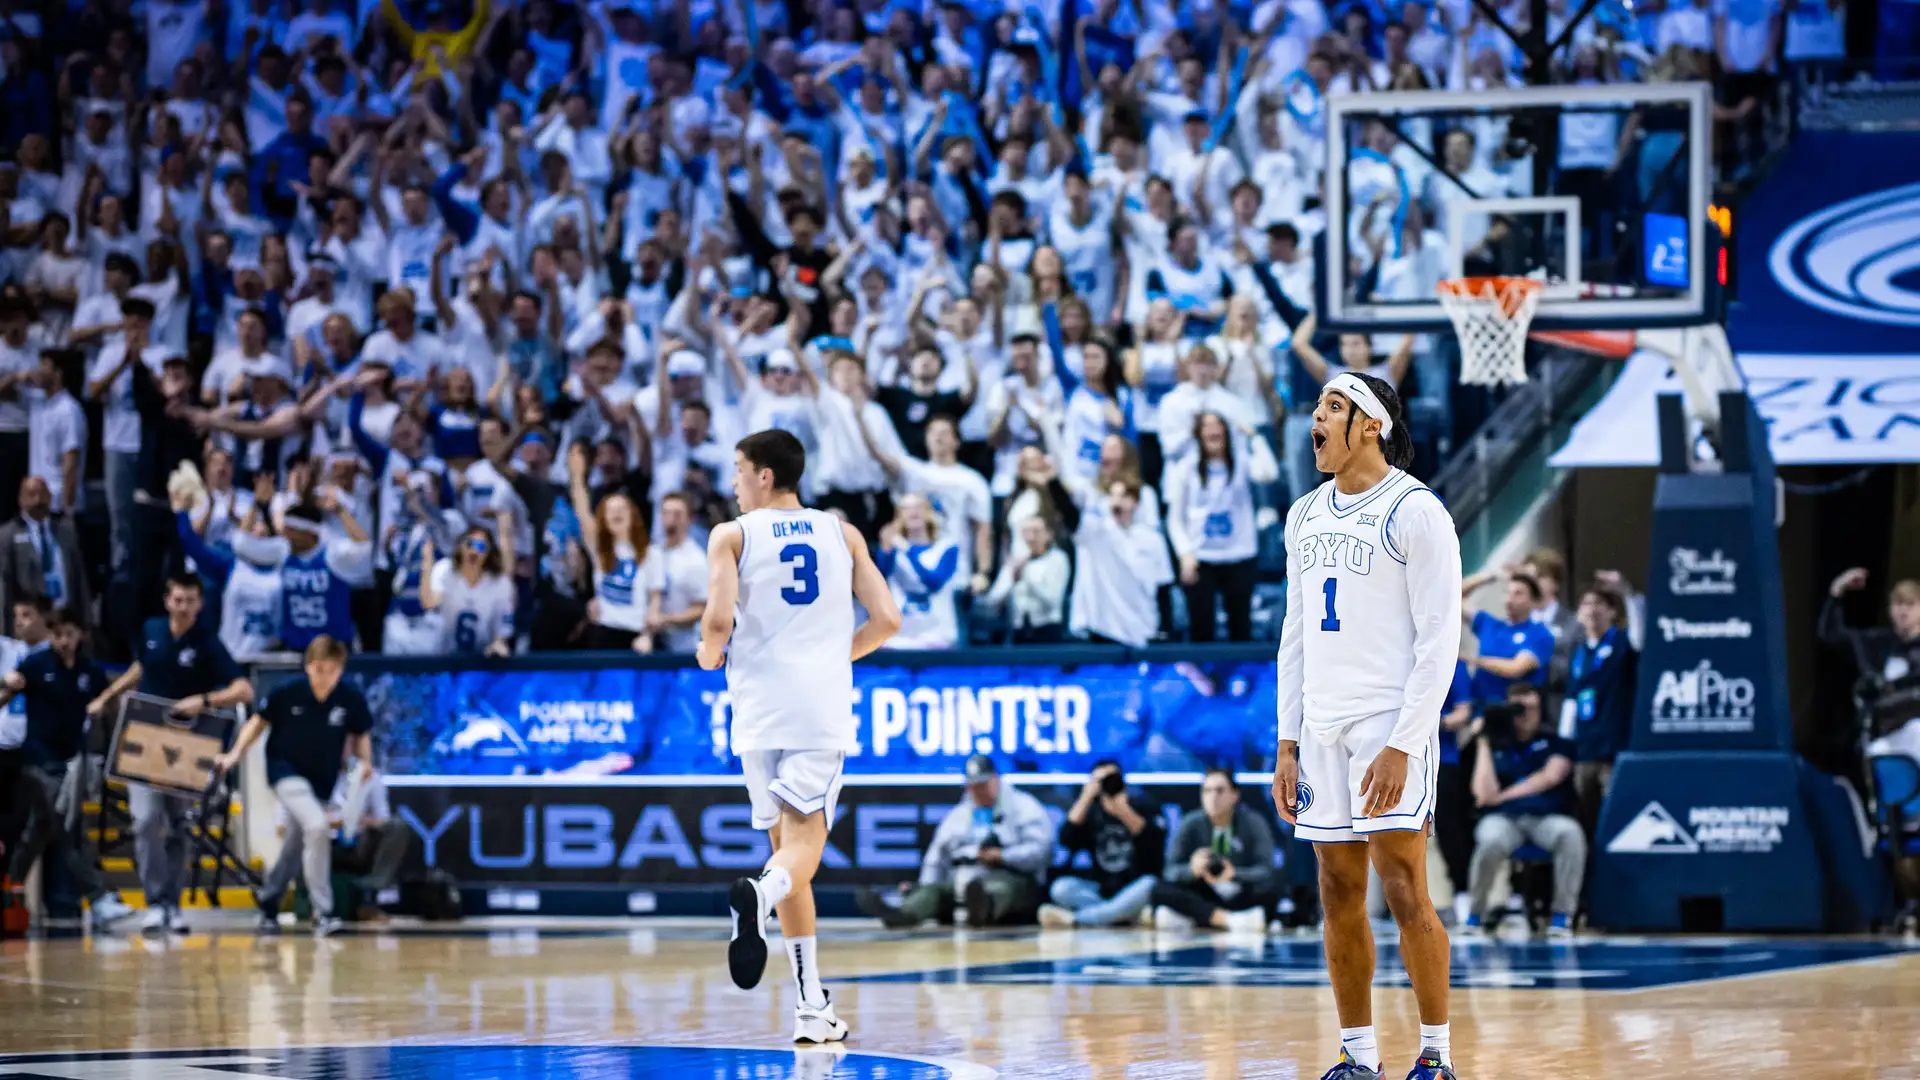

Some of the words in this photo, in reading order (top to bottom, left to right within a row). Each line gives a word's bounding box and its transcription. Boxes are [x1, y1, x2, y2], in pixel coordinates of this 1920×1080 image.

[772, 520, 814, 538] DEMIN
[780, 543, 820, 605] 3
[1298, 532, 1374, 576] BYU
[1321, 577, 1340, 632] 1
[872, 686, 1092, 756] POINTER
[1688, 807, 1788, 826] MOUNTAIN
[1694, 825, 1783, 843] AMERICA
